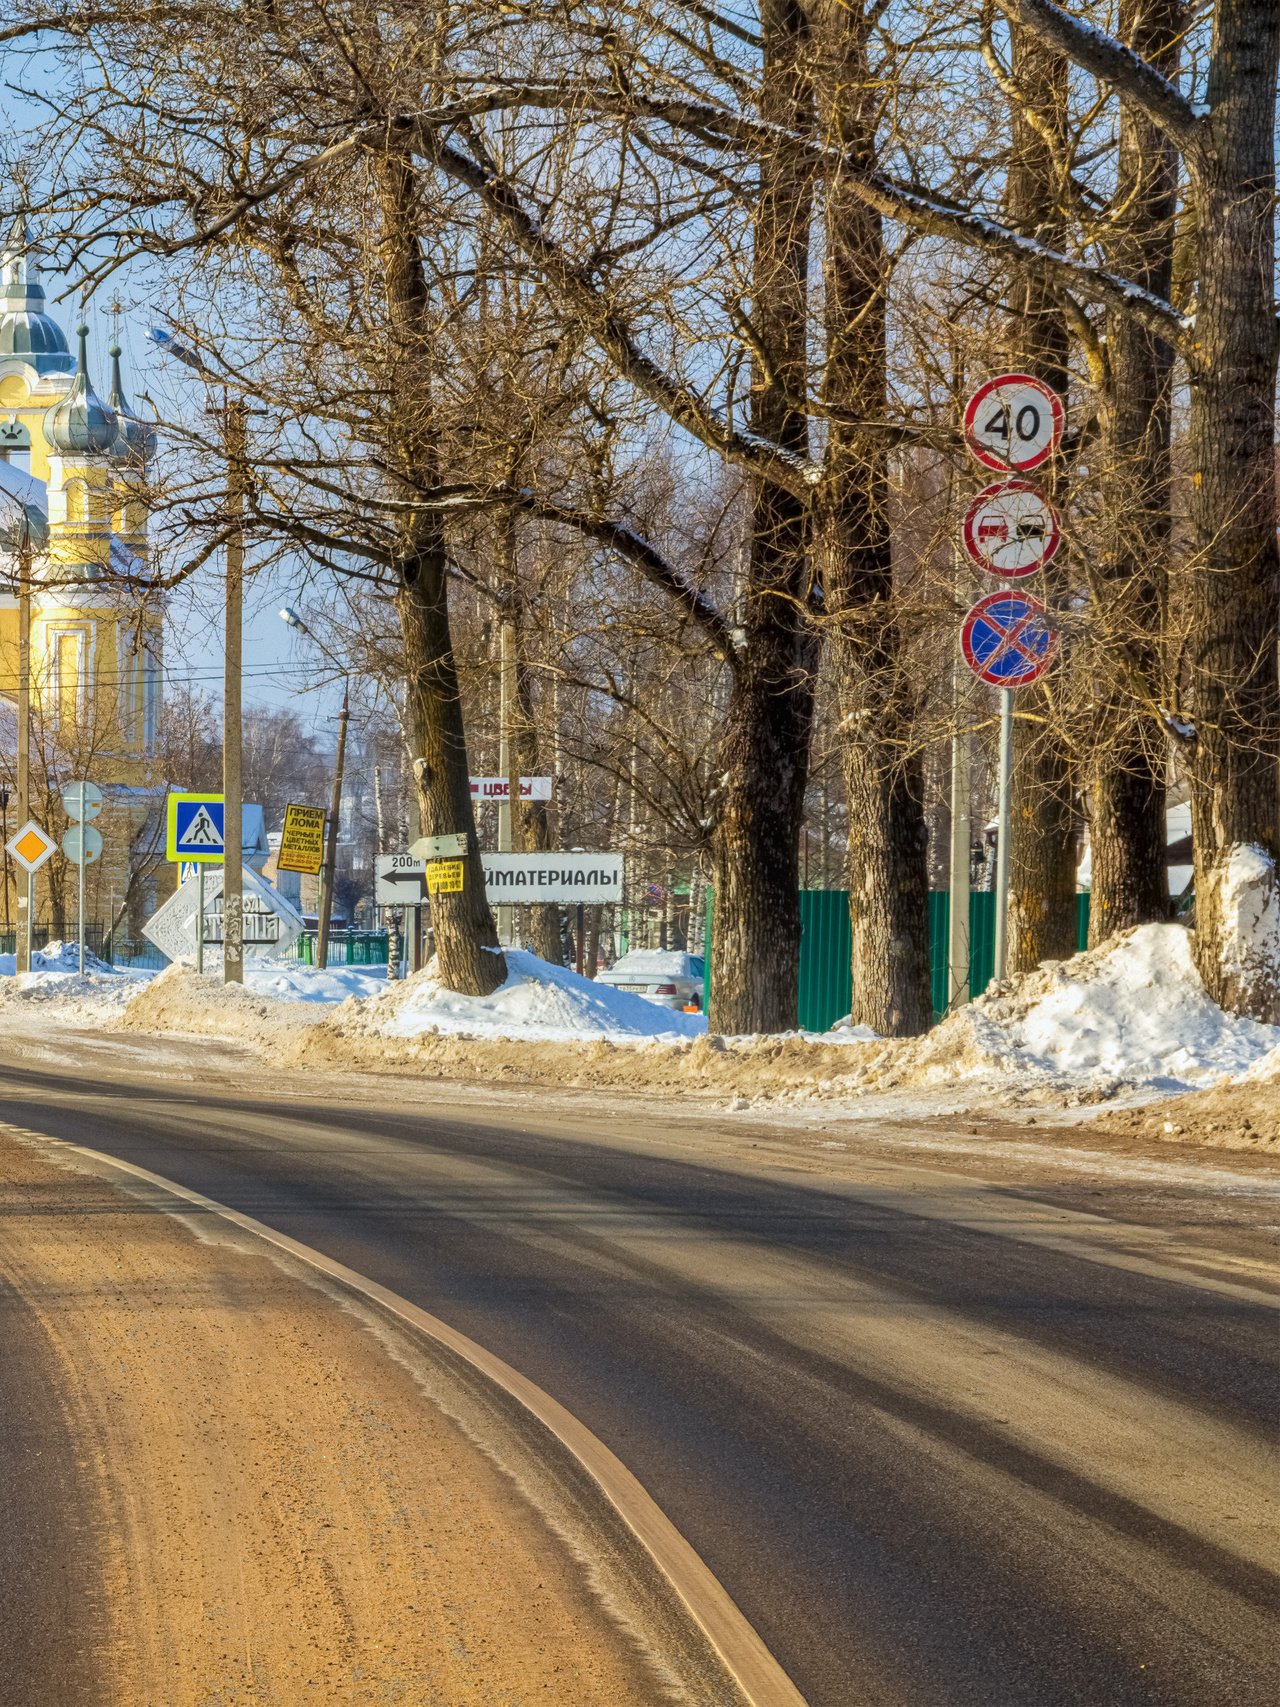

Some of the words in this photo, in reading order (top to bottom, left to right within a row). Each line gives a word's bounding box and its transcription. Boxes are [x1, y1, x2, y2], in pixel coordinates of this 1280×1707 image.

[985, 404, 1040, 442] 40
[483, 783, 532, 798] ЦВЕЫ
[289, 808, 323, 820] ПРИЕМ
[290, 818, 320, 829] ЛОМА
[286, 830, 315, 839] ЧЕРНЫХ
[286, 837, 319, 846] ЦВЕТНЫХ
[283, 843, 320, 853] МЕТАЛЛОВ
